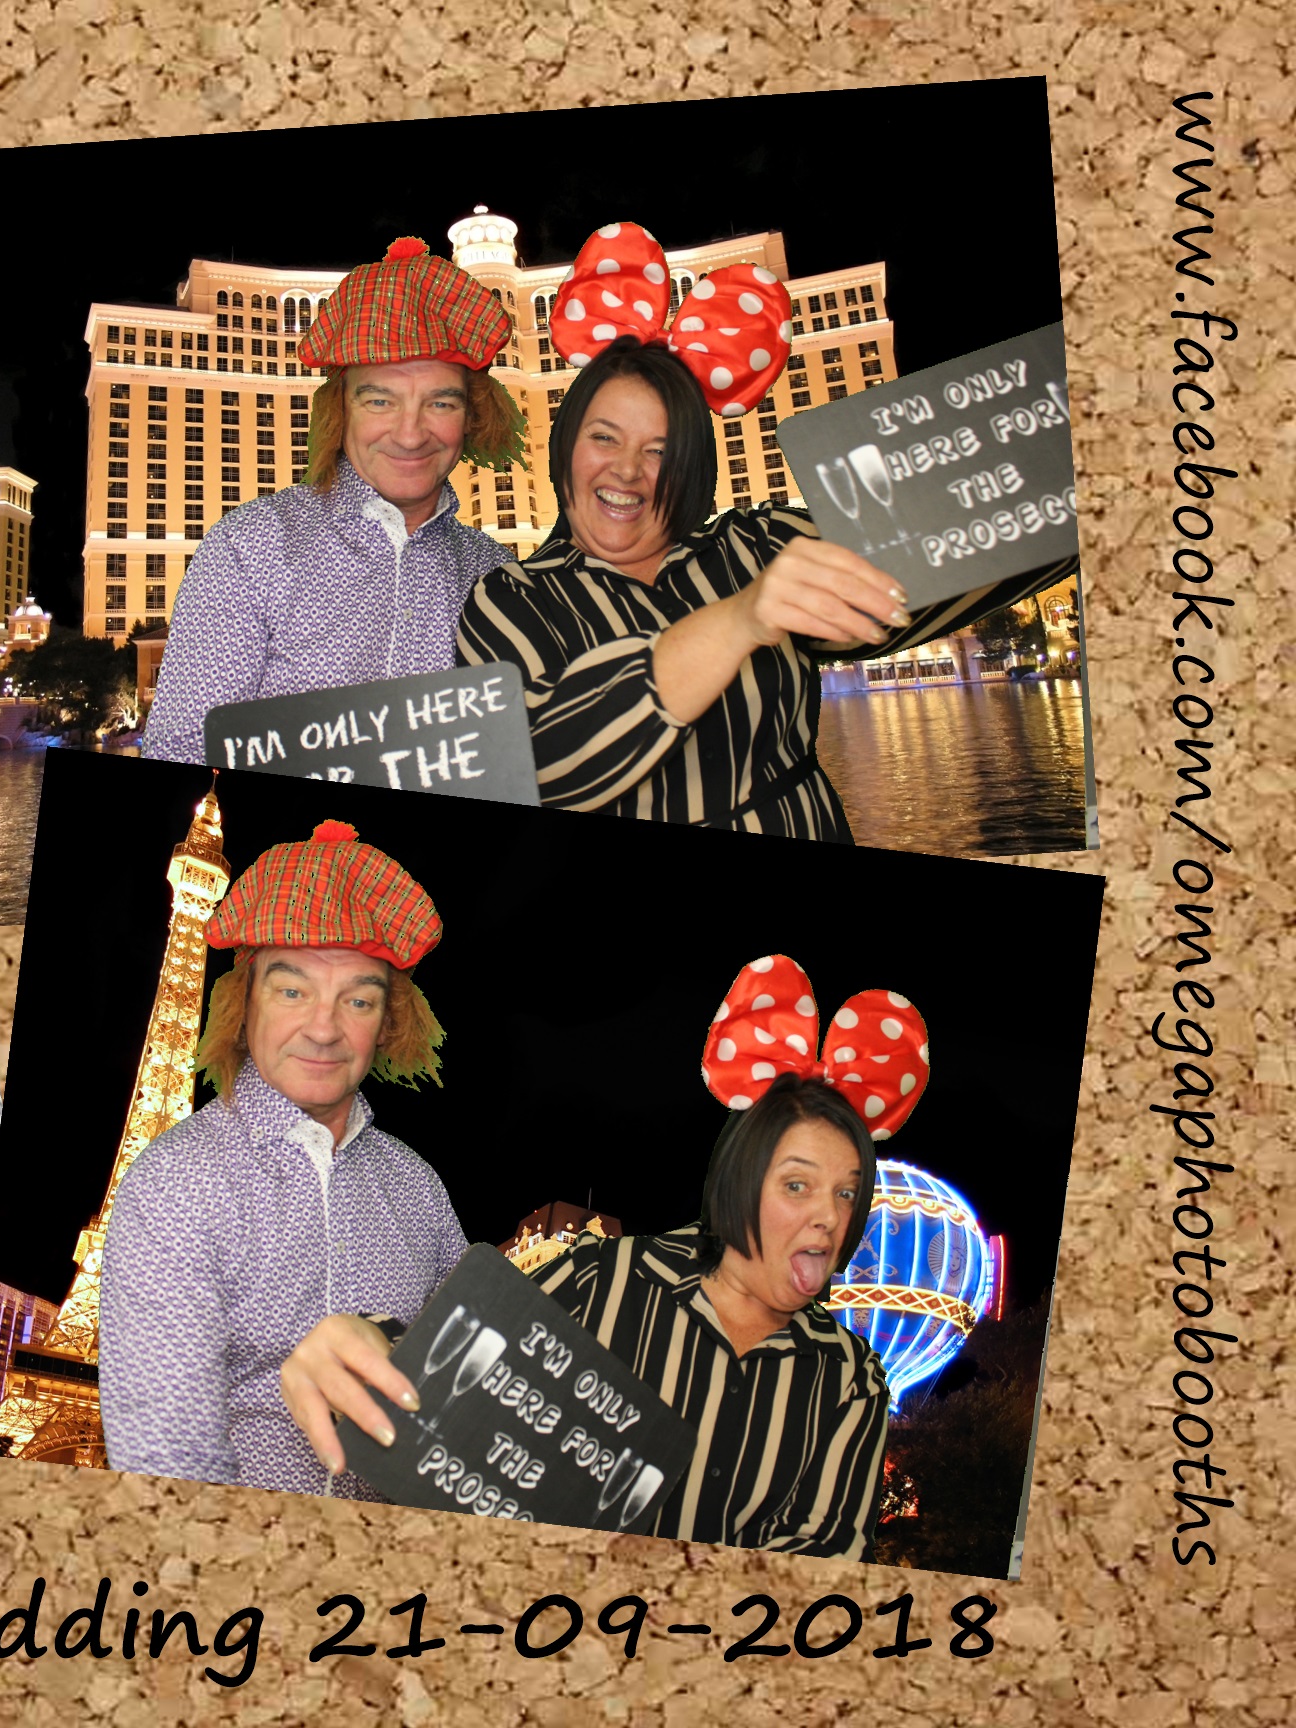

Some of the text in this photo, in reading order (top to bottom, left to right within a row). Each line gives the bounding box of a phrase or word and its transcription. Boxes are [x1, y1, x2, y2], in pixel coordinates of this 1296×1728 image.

[870, 359, 1027, 436] I'M ONLY
[883, 399, 1066, 481] HERE FOR
[947, 463, 1025, 509] THE
[223, 676, 508, 769] I'M ONLY HERE
[379, 732, 486, 790] THE
[519, 1321, 641, 1433] I'M ONLY
[481, 1360, 616, 1483] HERE FOR
[486, 1431, 546, 1489] THE
